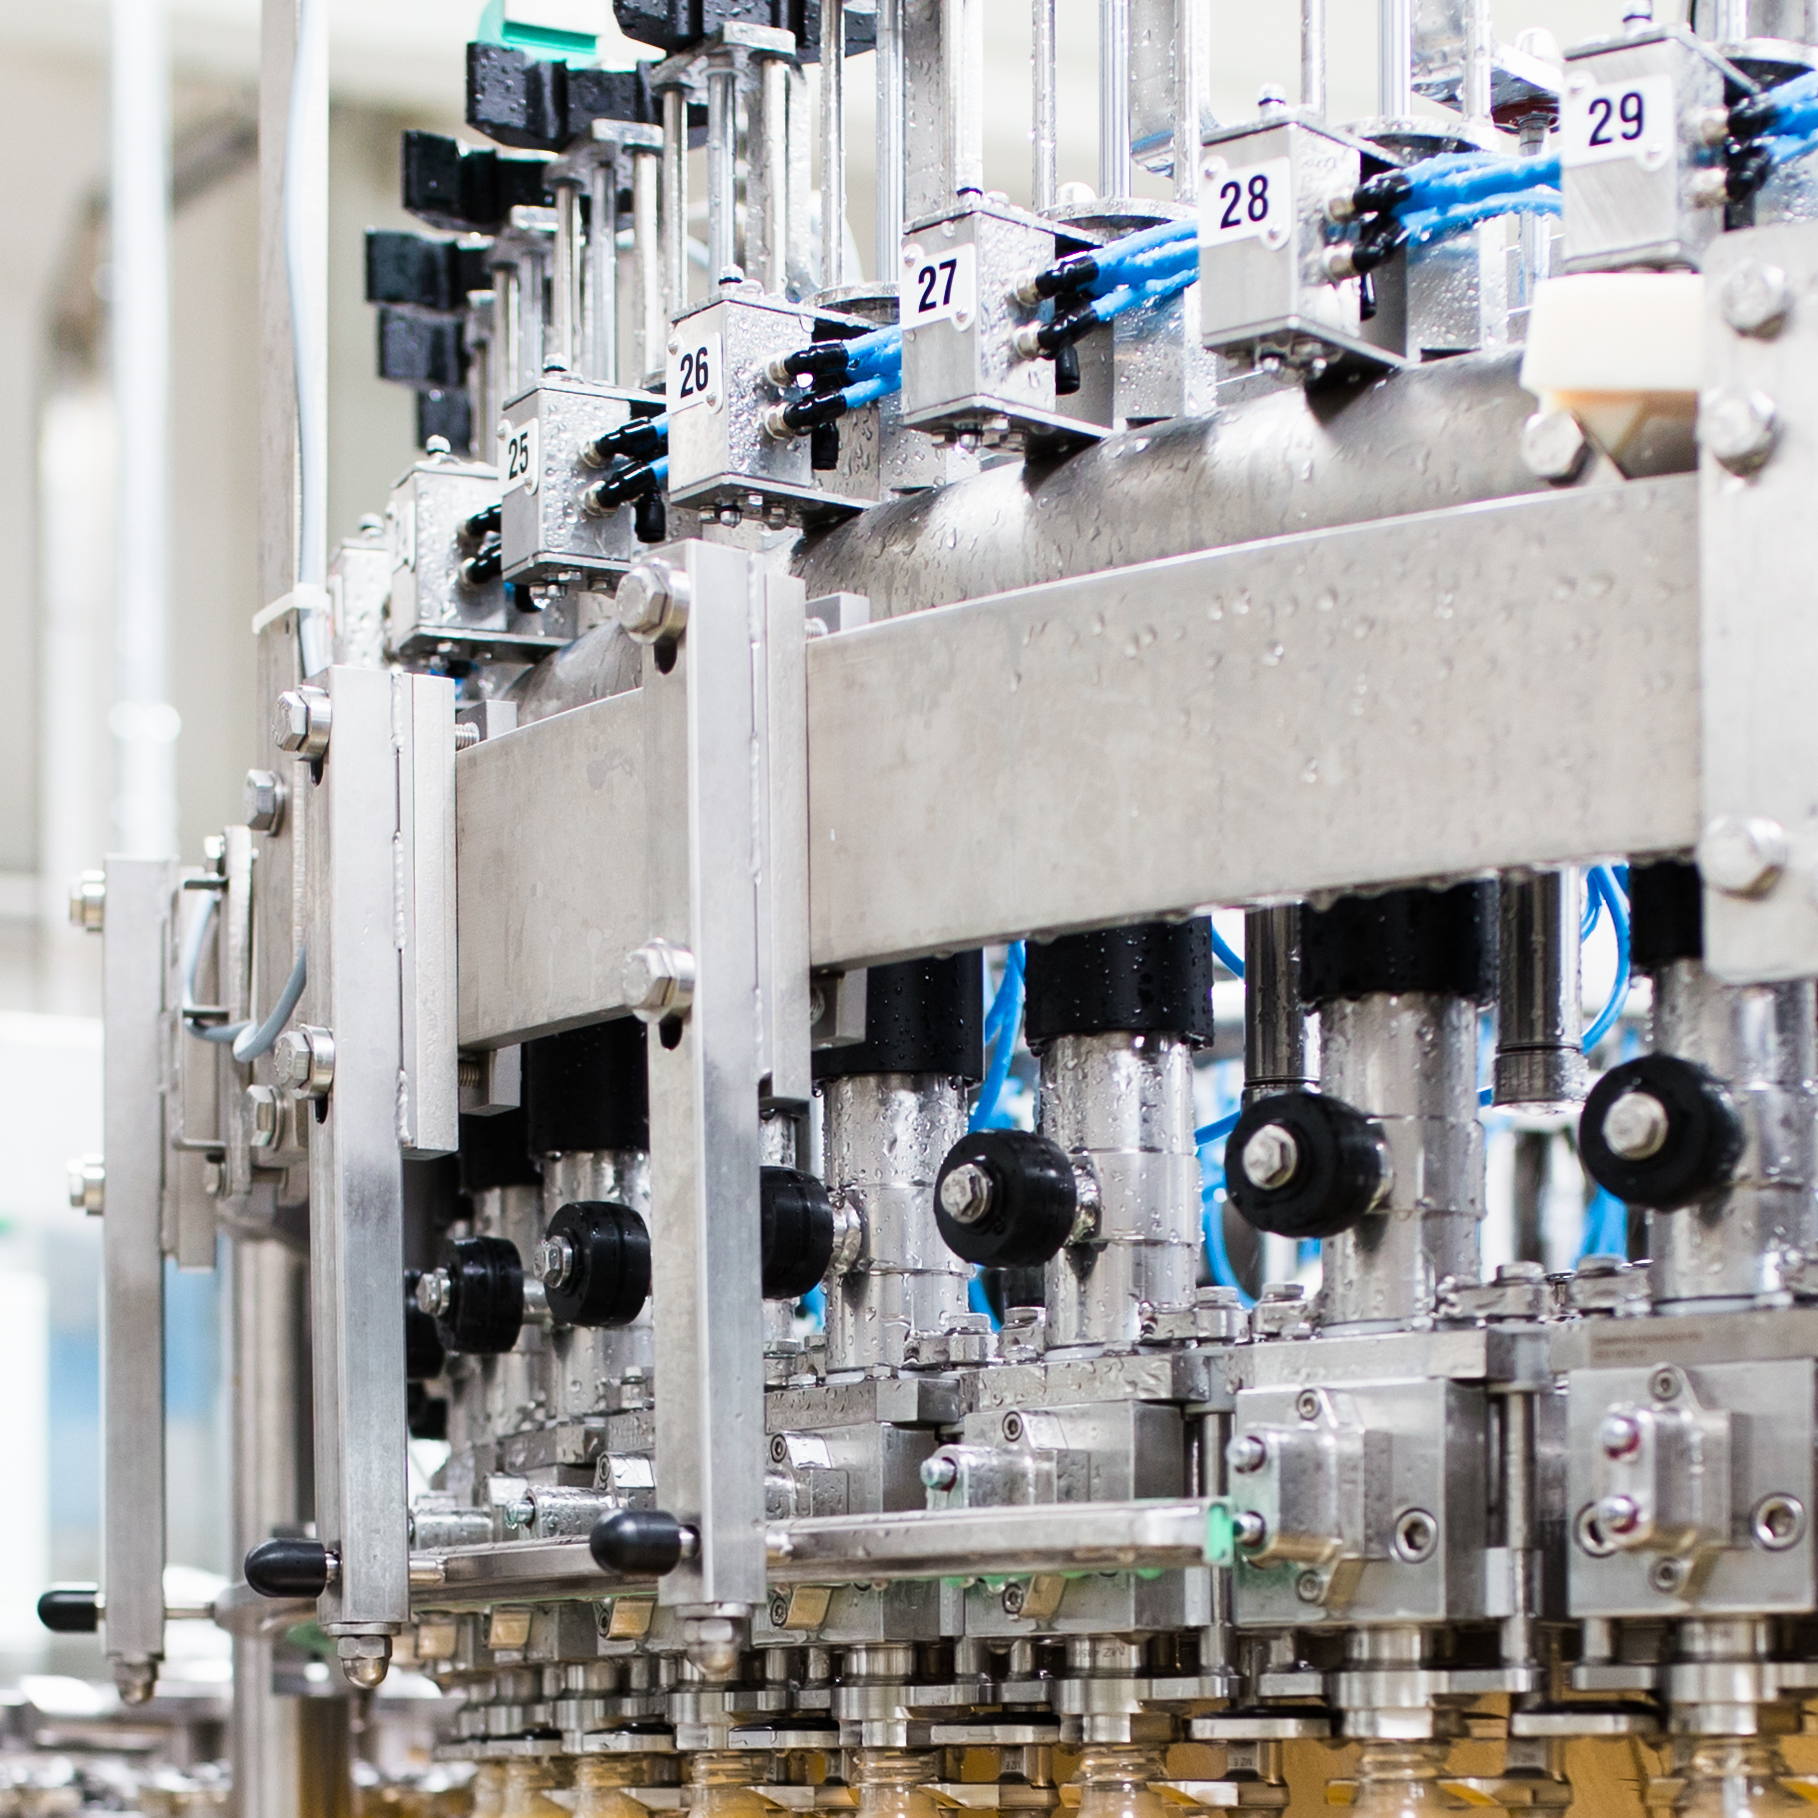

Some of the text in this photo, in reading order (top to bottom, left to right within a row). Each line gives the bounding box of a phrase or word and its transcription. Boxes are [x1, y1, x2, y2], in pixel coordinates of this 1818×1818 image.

[1588, 91, 1644, 147] 29
[1220, 174, 1269, 230] 28
[917, 258, 957, 314] 27
[680, 346, 709, 399] 26
[508, 431, 529, 481] 25
